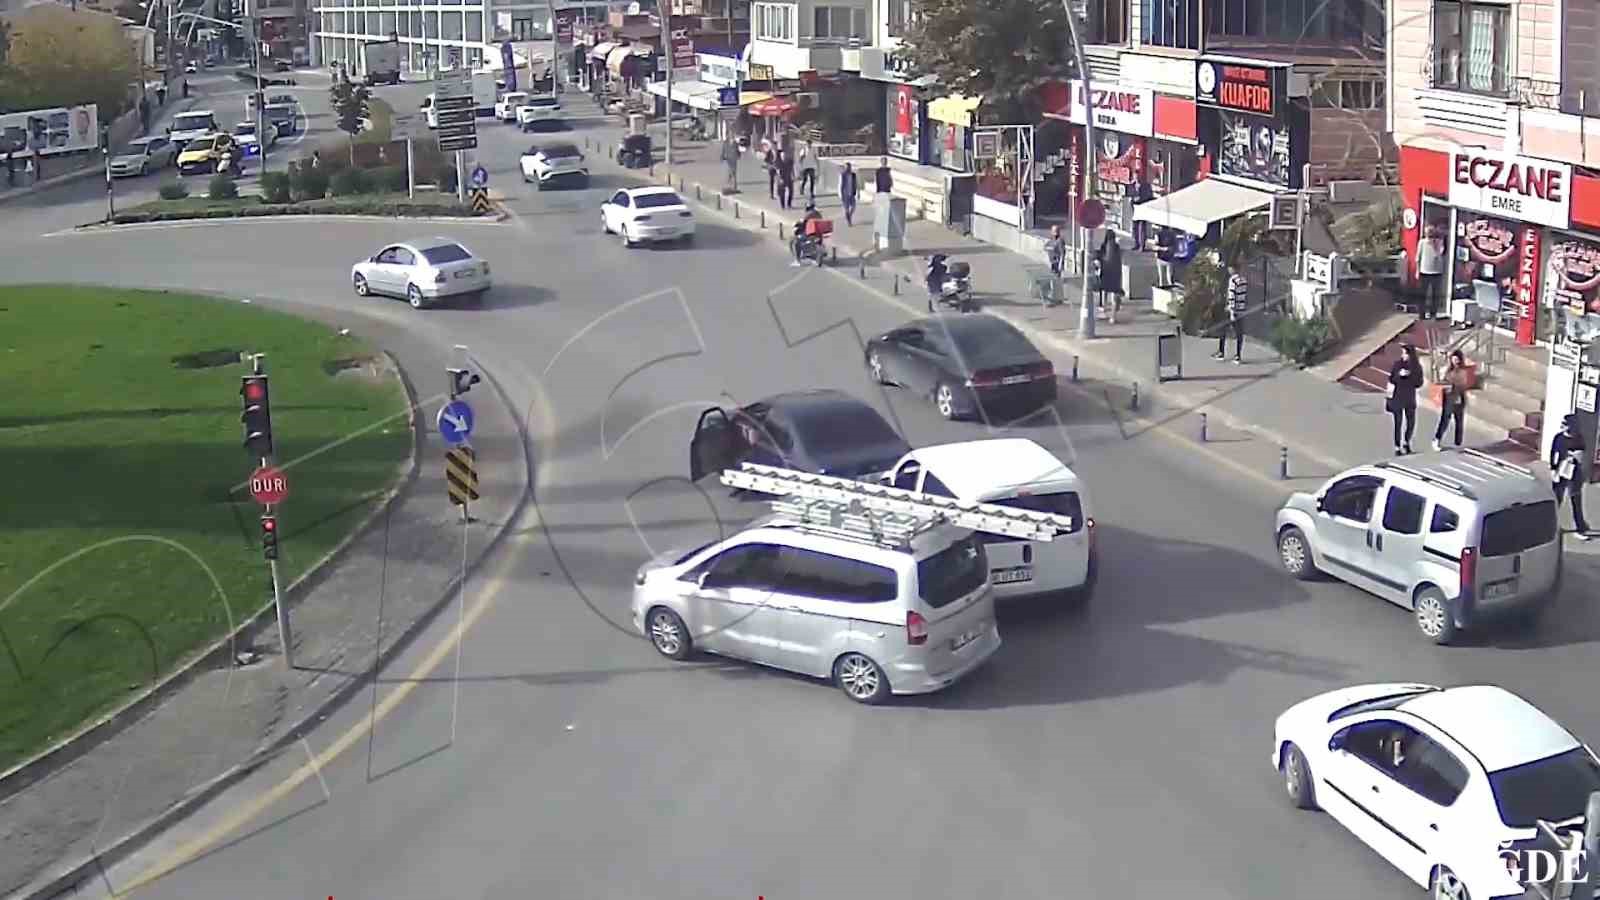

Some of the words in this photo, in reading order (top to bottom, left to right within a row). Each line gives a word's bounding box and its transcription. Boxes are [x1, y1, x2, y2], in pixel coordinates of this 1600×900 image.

[1455, 153, 1562, 203] ECZANE
[1492, 196, 1522, 213] EMRE
[1520, 228, 1537, 318] ECZANE
[253, 478, 281, 493] DUR
